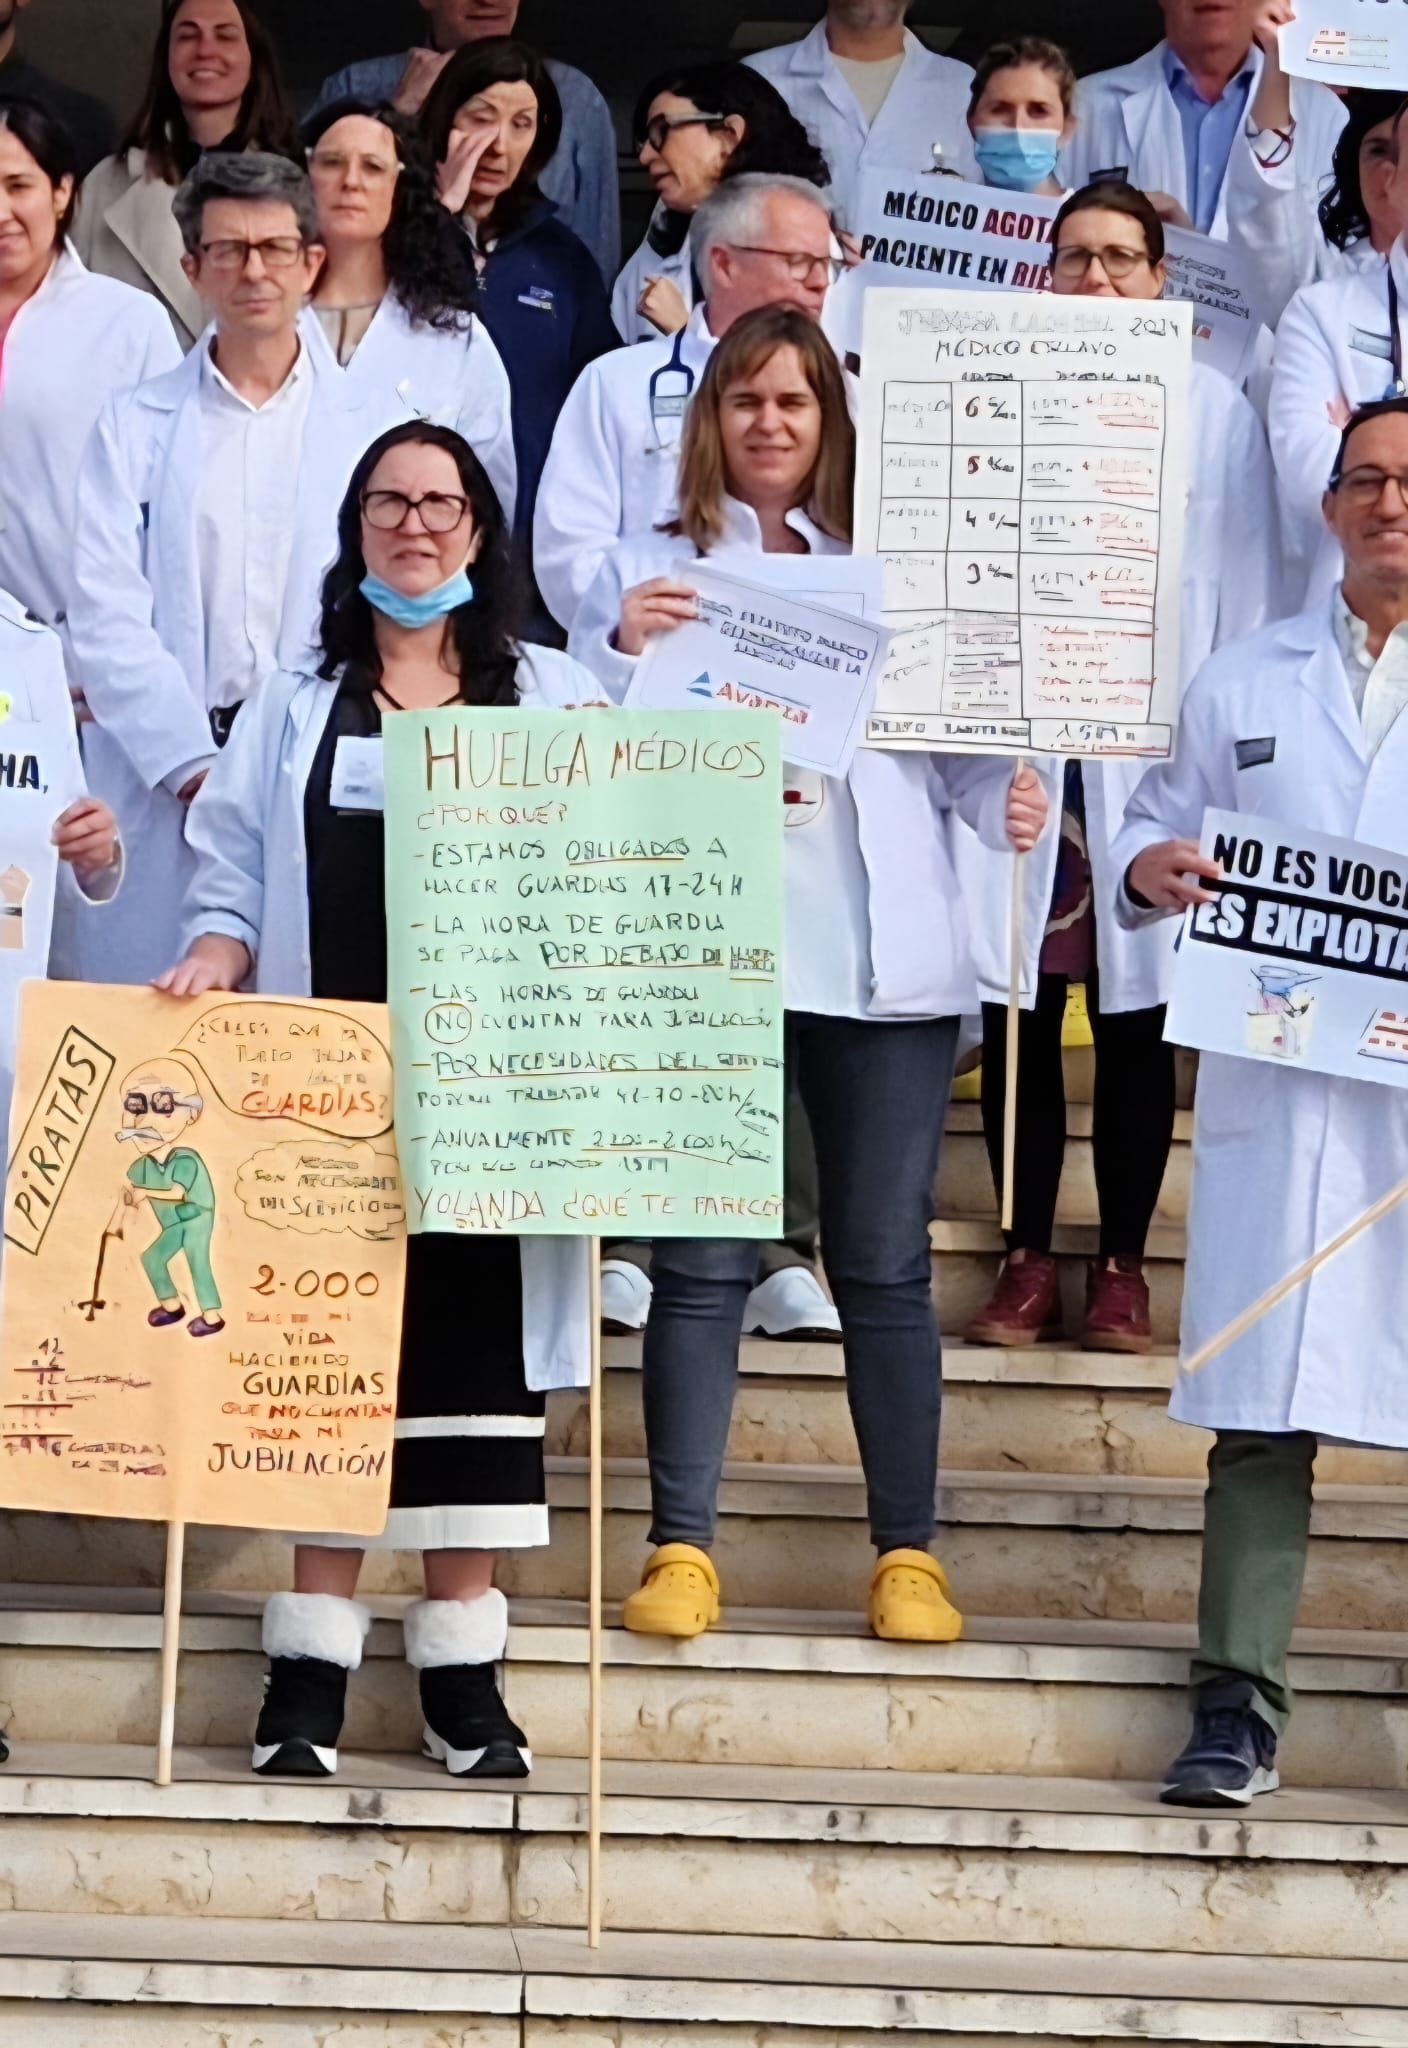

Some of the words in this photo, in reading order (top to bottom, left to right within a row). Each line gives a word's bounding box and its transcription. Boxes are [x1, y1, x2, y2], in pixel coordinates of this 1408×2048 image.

[884, 190, 979, 230] MÉDICO
[860, 234, 972, 279] PACIENTE
[976, 255, 1008, 284] EN
[423, 723, 591, 791] HUELGA
[611, 731, 766, 779] MÉDICOS
[0, 753, 49, 794] HA,
[432, 840, 546, 868] ESTAMOS
[707, 837, 728, 859] A
[1213, 833, 1264, 879] NO
[1273, 845, 1317, 889] ES
[435, 914, 465, 935] LA
[482, 914, 551, 935] HORA
[565, 914, 603, 934] DE
[1195, 893, 1247, 939] ES
[456, 944, 521, 965] PAGA
[539, 941, 589, 968] POR
[600, 943, 690, 967] DEBAJO
[433, 984, 478, 1002] LAS
[501, 984, 572, 1003] HORAS
[434, 1011, 468, 1031] NO
[431, 1051, 481, 1077] POR
[659, 1052, 709, 1071] DEL
[14, 1043, 97, 1232] PIRATAS
[431, 1129, 576, 1150] ANUALMENTE
[414, 1187, 546, 1224] YOLANDA
[563, 1188, 629, 1220] ¿QUÉ
[641, 1194, 678, 1214] TE
[229, 1351, 350, 1368] HACIENDO
[242, 1371, 385, 1397] GUARDIAS
[207, 1443, 386, 1477] JUBILACIÓN
